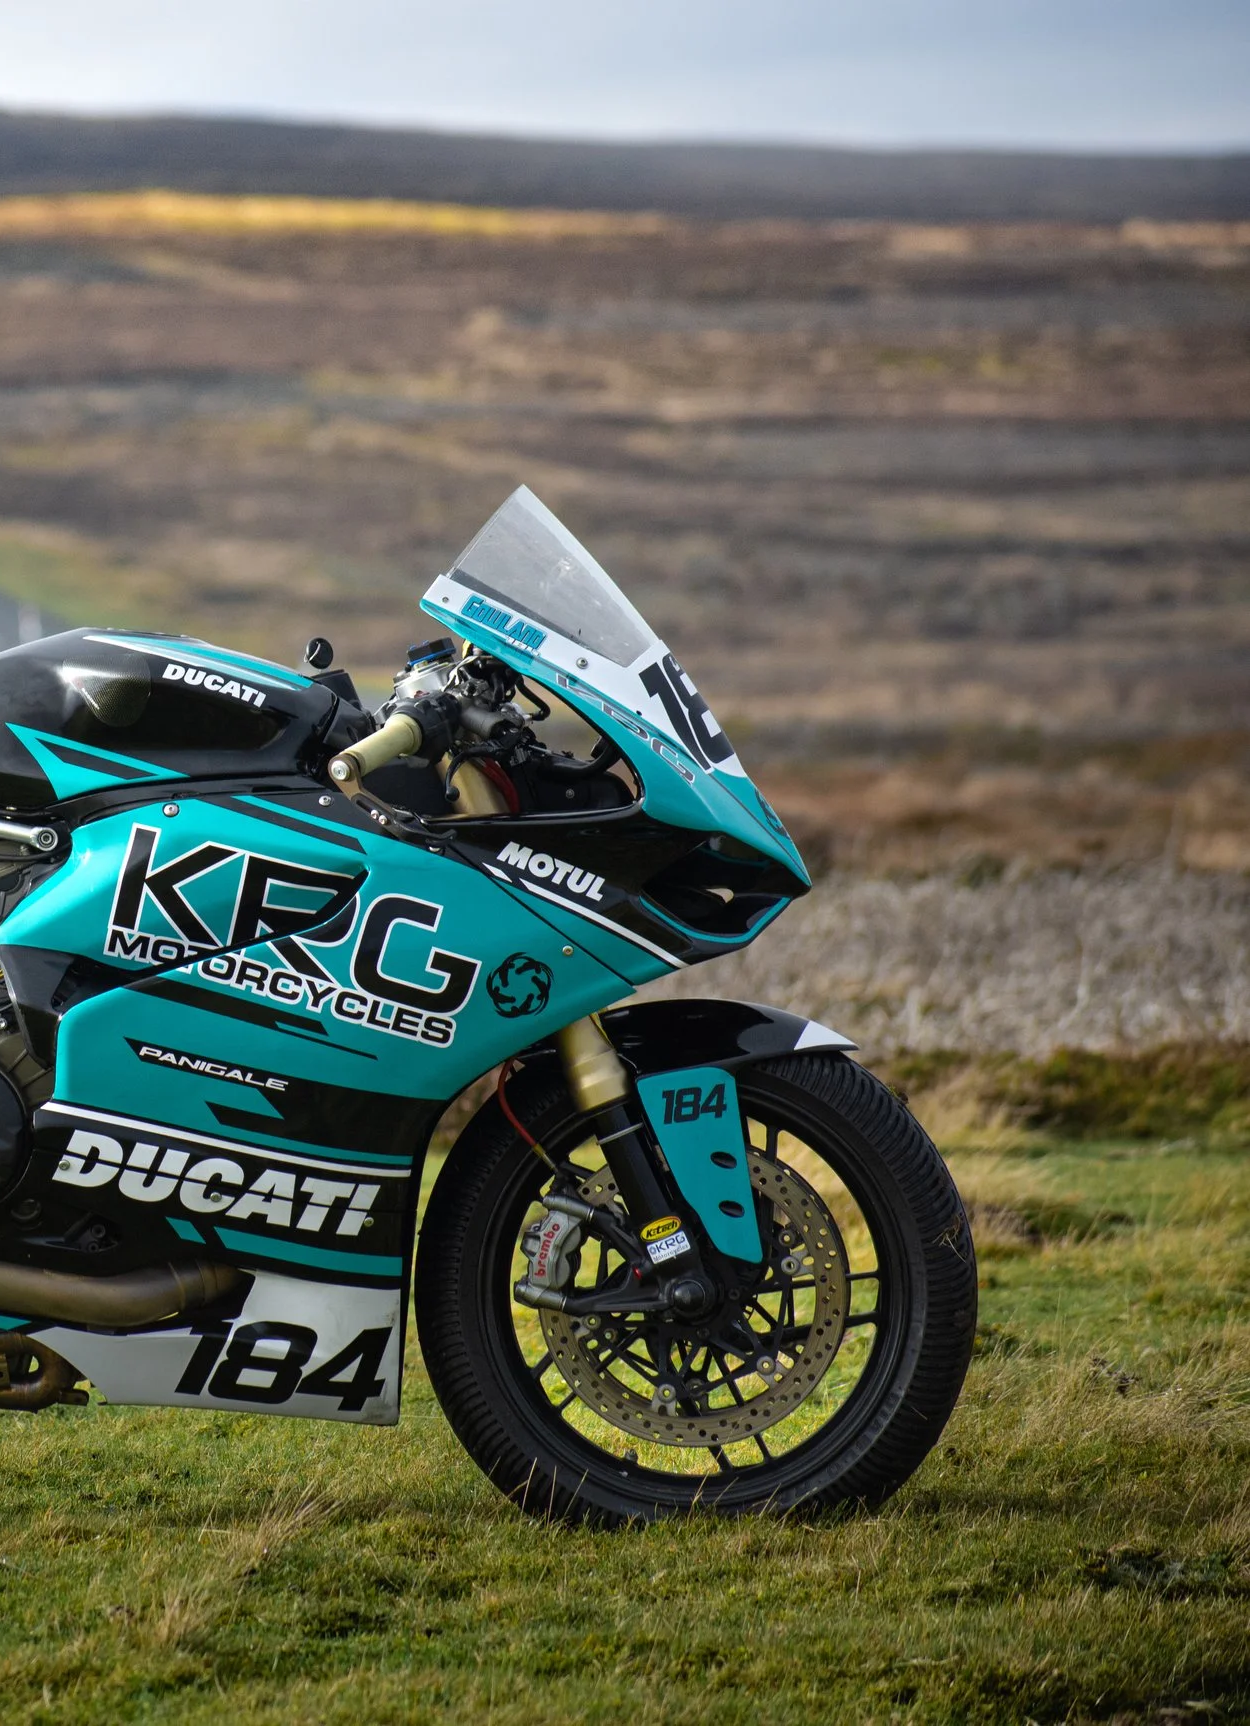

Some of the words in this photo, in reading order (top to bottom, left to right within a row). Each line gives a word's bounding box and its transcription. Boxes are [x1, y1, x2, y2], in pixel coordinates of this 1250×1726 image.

[461, 595, 546, 650] GOWLAND
[161, 662, 267, 708] DUCATI
[496, 841, 606, 902] MOTUL
[108, 823, 482, 1016] KRG
[105, 926, 456, 1047] MOTORCYCLES
[139, 1046, 289, 1092] PANIGALE
[661, 1083, 728, 1125] 184
[52, 1129, 381, 1237] DUCATI
[535, 1223, 560, 1277] brembo
[655, 1234, 686, 1253] KRG
[174, 1319, 393, 1412] 184
